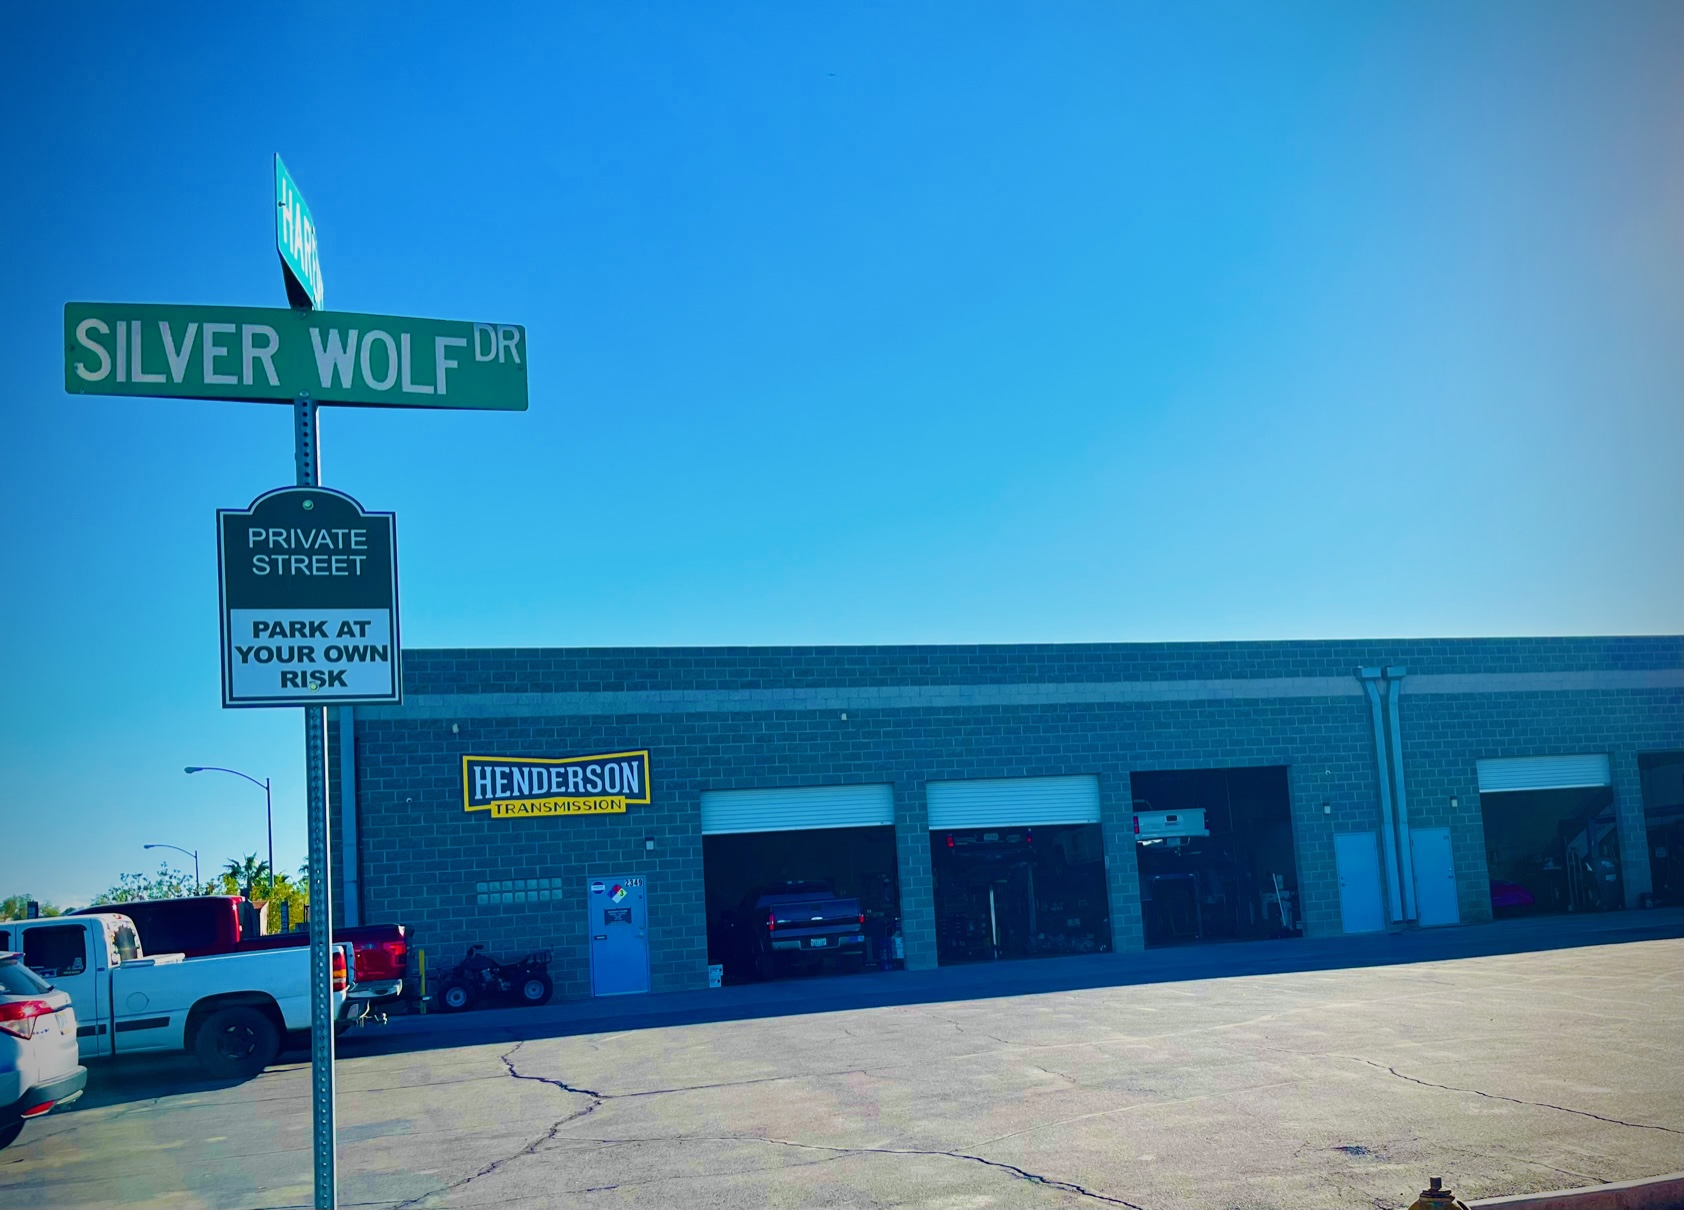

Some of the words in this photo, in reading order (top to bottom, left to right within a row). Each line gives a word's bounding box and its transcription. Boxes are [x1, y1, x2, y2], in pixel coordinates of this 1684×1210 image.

[75, 317, 280, 386] SILVER
[309, 327, 467, 395] WOLF
[473, 322, 521, 364] DR
[248, 528, 367, 549] PRIVATE
[252, 555, 366, 576] STREET
[252, 620, 328, 638] PARK
[336, 620, 371, 638] AT
[234, 645, 316, 664] YOUR
[323, 644, 388, 663] OWN
[280, 669, 348, 688] RISK
[474, 761, 639, 800] HENDERSON
[494, 799, 622, 815] TRANSMISSION
